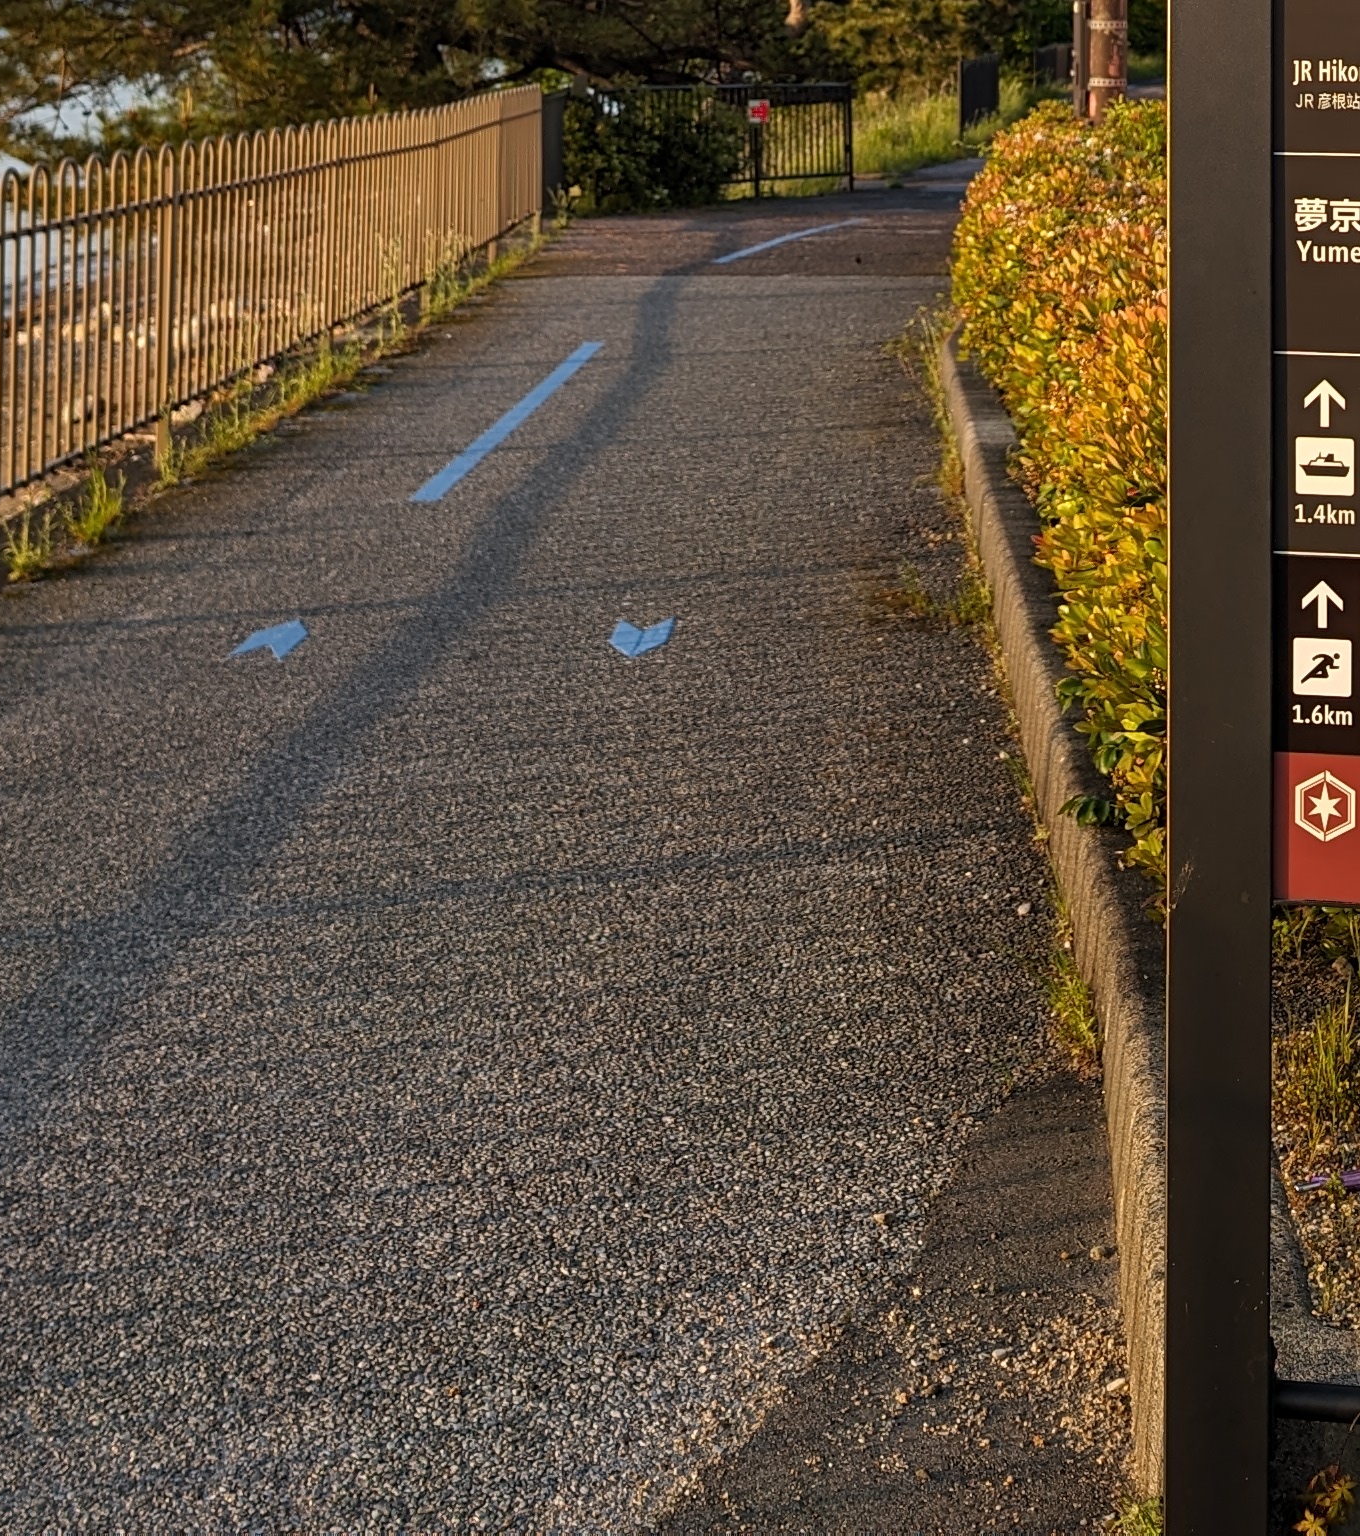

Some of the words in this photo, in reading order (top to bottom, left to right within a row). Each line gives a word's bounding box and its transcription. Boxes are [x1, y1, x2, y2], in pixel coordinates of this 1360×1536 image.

[1292, 59, 1313, 86] JR
[1295, 93, 1314, 109] JR
[1294, 503, 1355, 525] 1.4km
[1292, 704, 1353, 726] 1.6km
